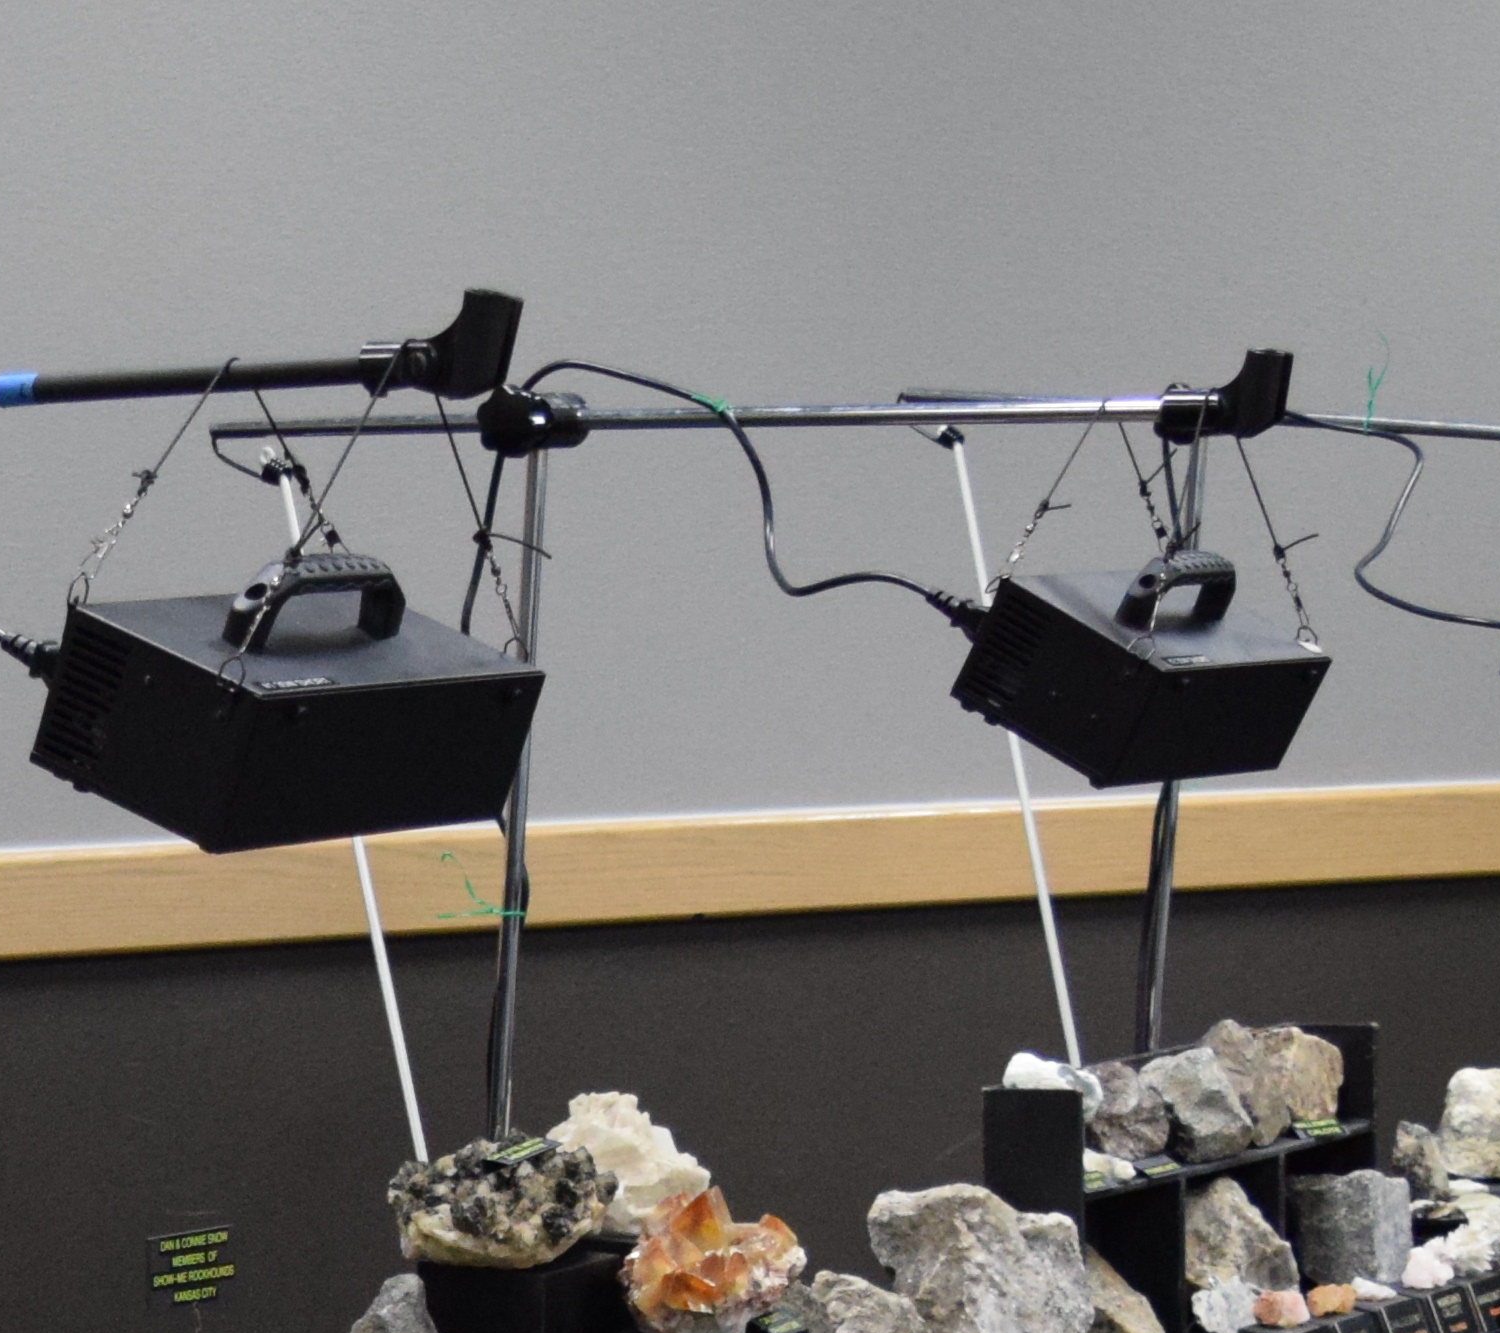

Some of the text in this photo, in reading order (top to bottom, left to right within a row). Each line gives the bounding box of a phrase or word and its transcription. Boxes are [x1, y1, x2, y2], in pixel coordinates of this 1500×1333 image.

[172, 1250, 217, 1267] MEMBERS OF
[188, 1264, 234, 1282] ROCKHOUNDS
[174, 1286, 216, 1302] KANSAS CITY
